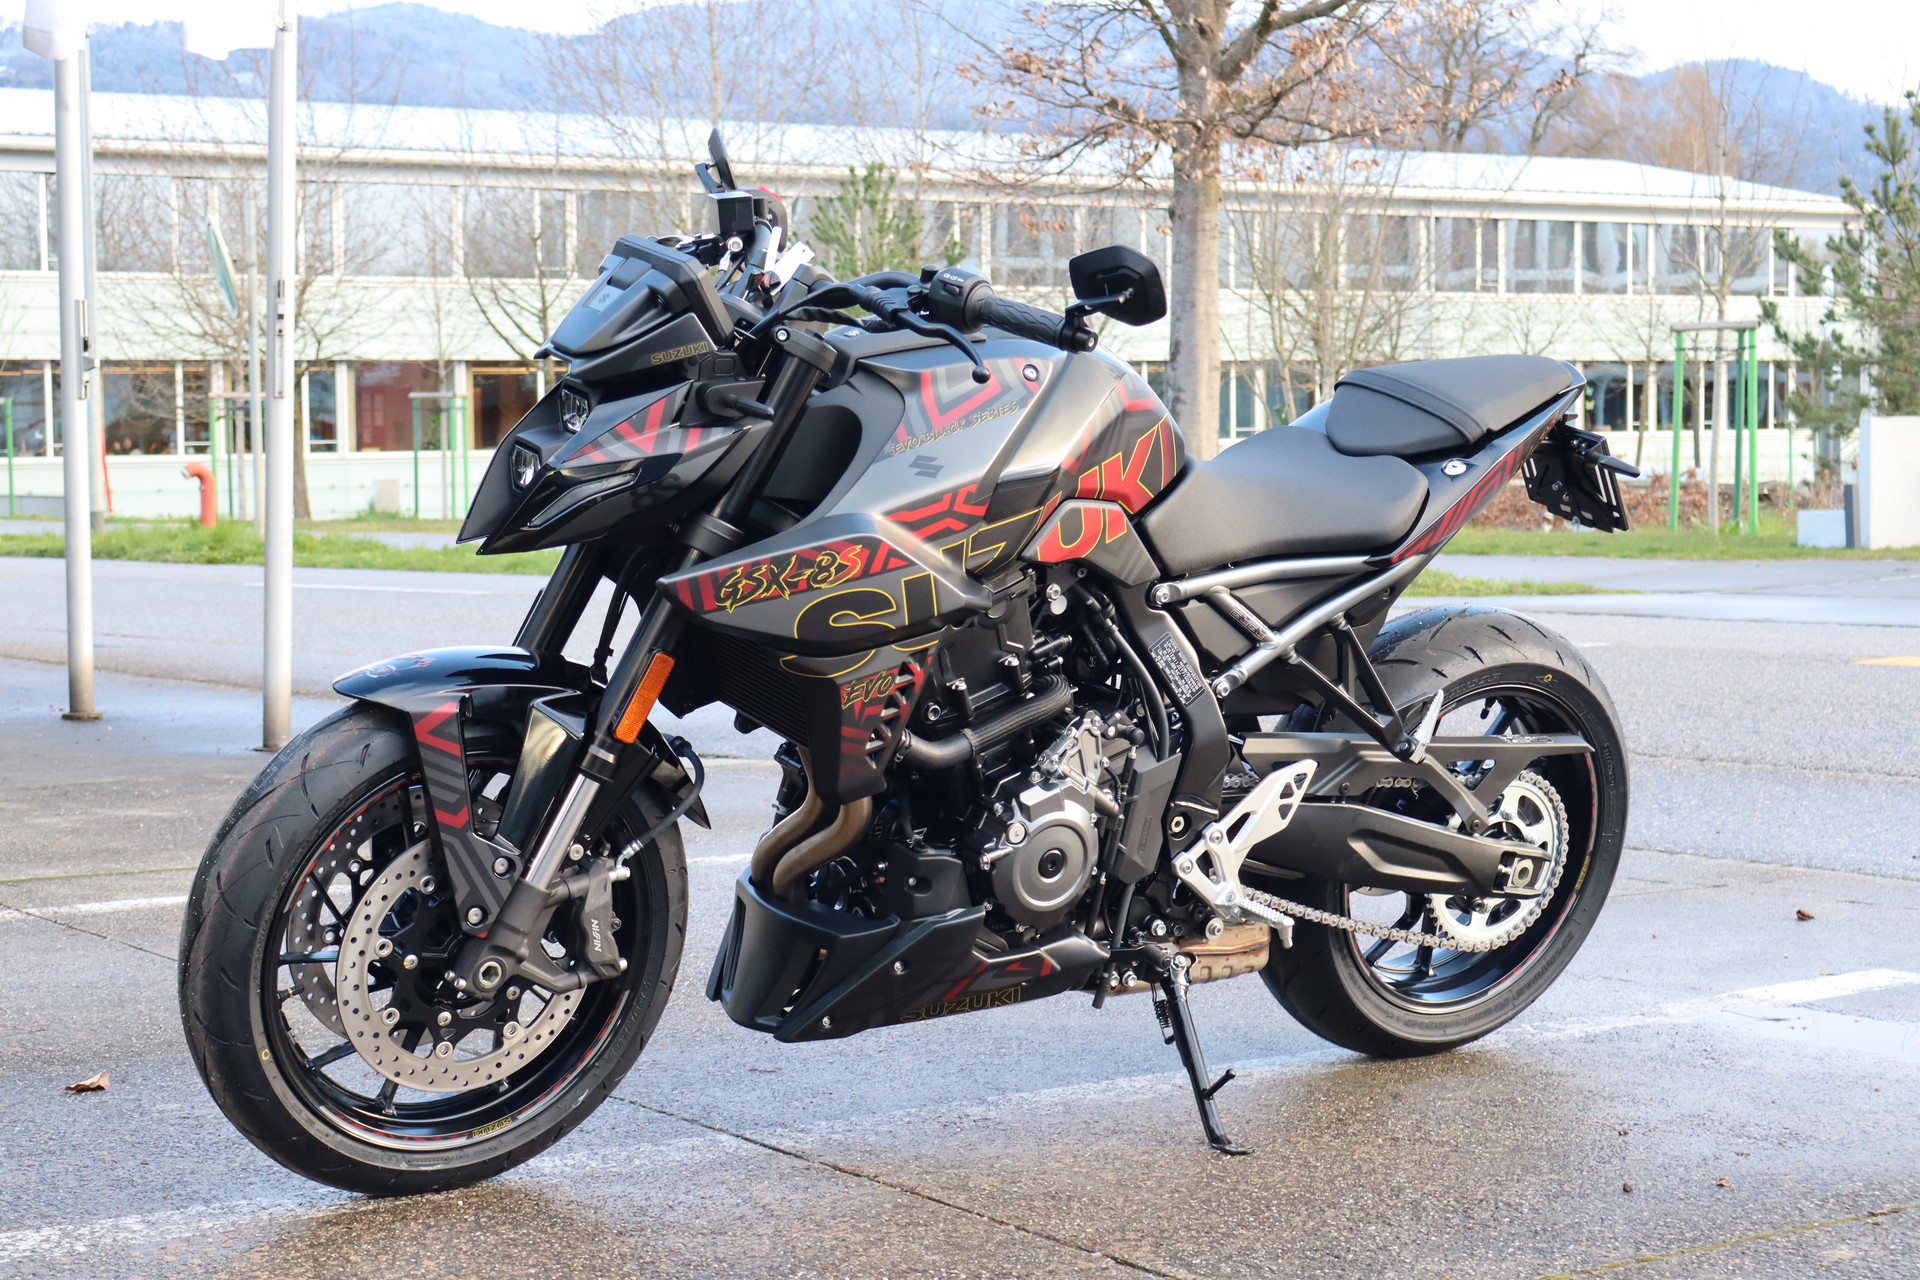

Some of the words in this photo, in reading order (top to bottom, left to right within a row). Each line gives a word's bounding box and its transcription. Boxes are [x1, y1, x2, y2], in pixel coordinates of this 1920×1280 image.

[651, 341, 709, 365] SUZUKI
[891, 436, 921, 456] EVO
[920, 419, 968, 446] BLACK
[966, 402, 1020, 428] SERIES
[714, 544, 863, 614] GSX-8S
[842, 670, 896, 710] EVO
[900, 985, 1022, 1022] SUZUKI
